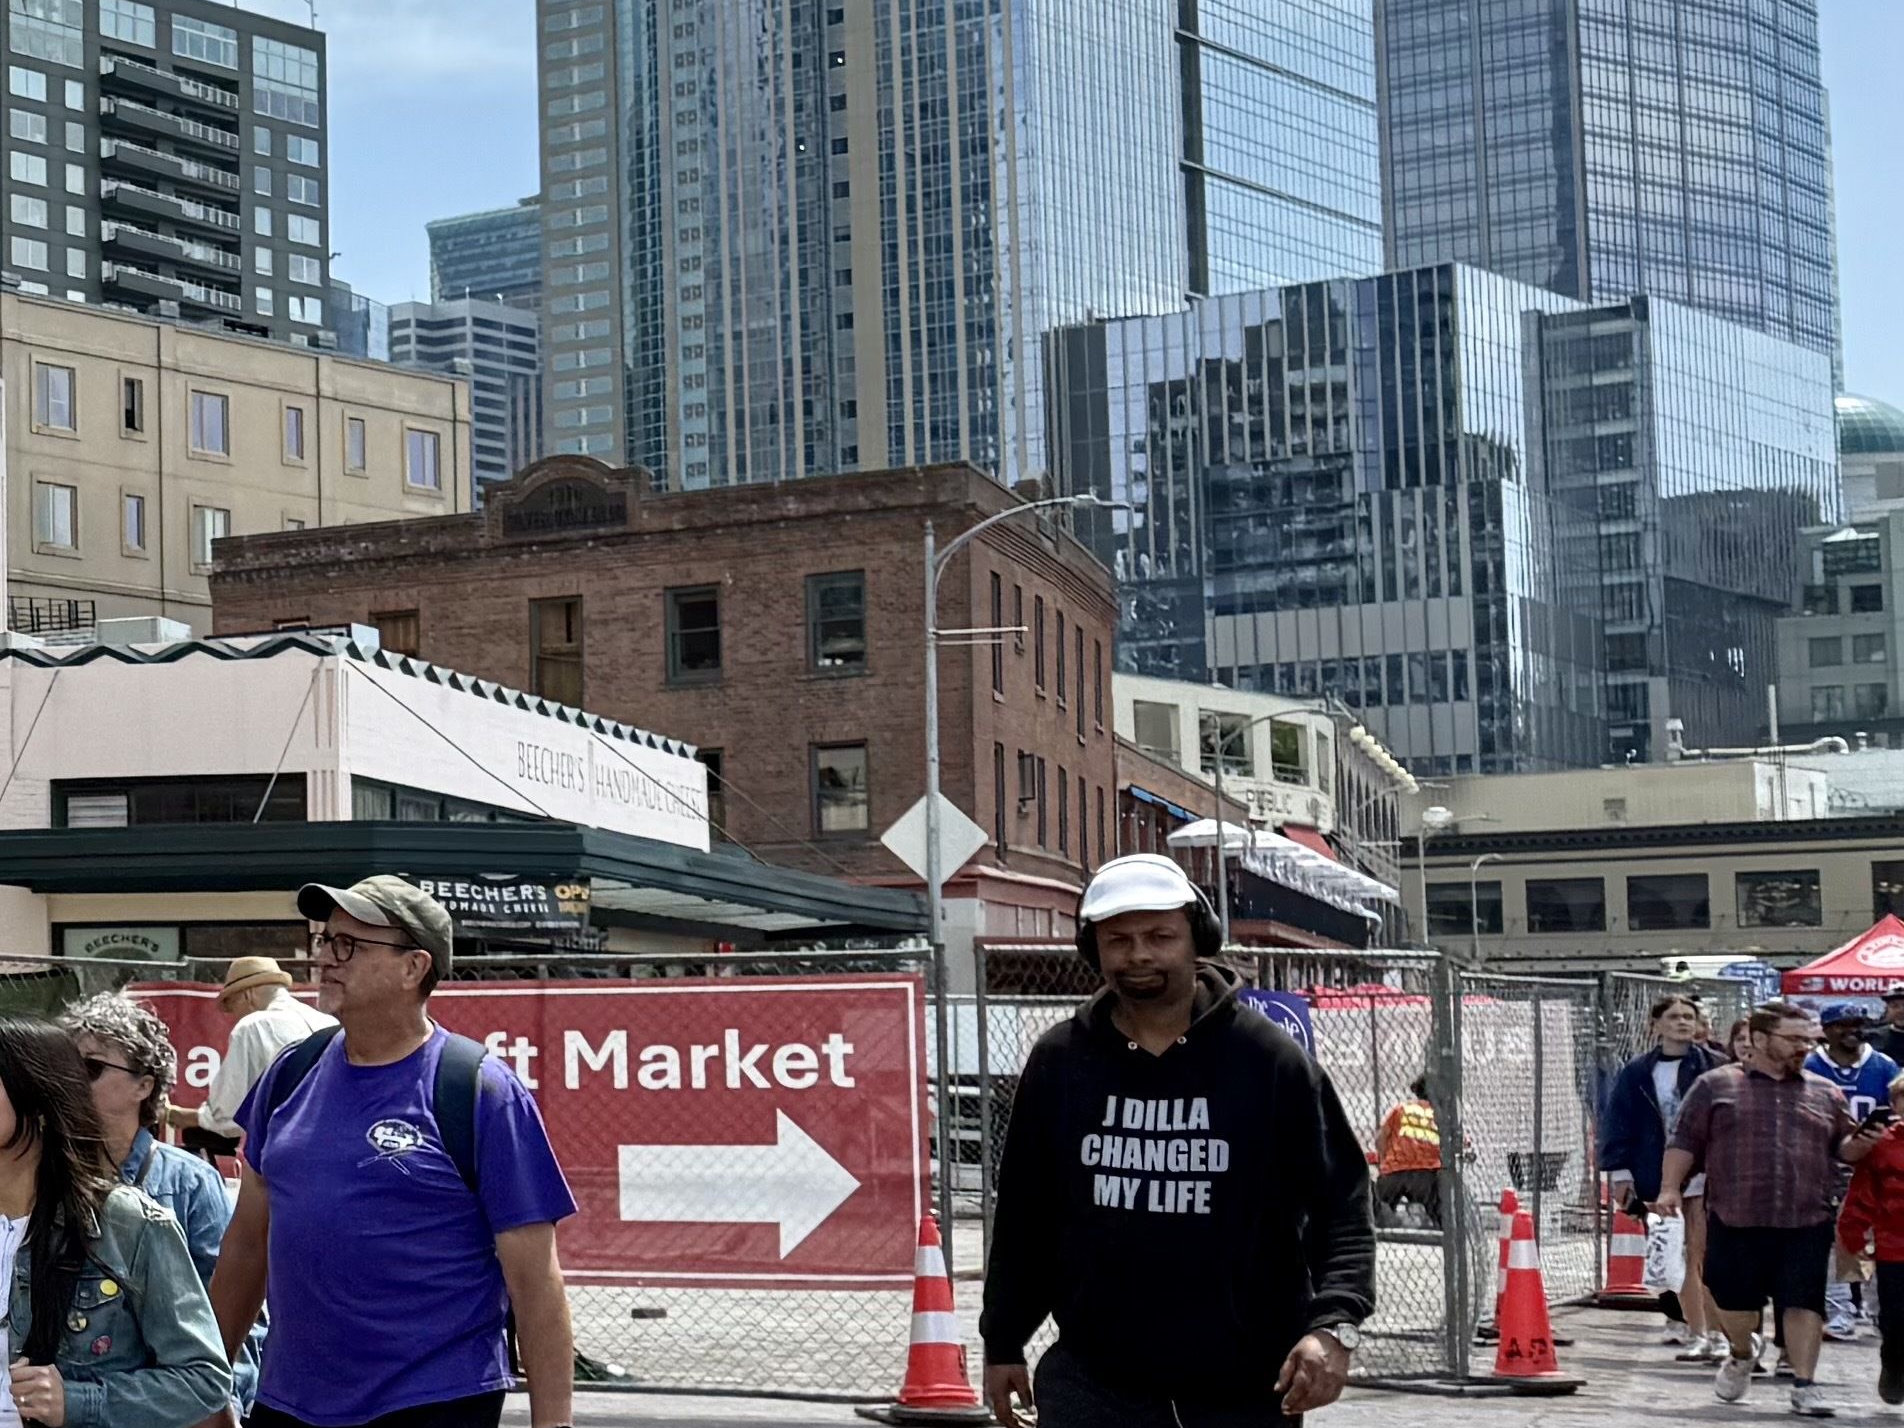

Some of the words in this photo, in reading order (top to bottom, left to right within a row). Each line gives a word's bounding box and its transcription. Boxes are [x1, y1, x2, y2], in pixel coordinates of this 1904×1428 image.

[517, 741, 585, 793] BEECHER'S
[419, 880, 547, 902] BEECHER'S
[84, 933, 160, 954] BEECHER'S
[563, 1028, 856, 1091] Market
[1102, 1095, 1117, 1127] J
[1122, 1097, 1210, 1131] DILLA
[1080, 1133, 1230, 1172] CHANGED
[1094, 1174, 1141, 1210] MY
[1148, 1180, 1212, 1214] LIFE
